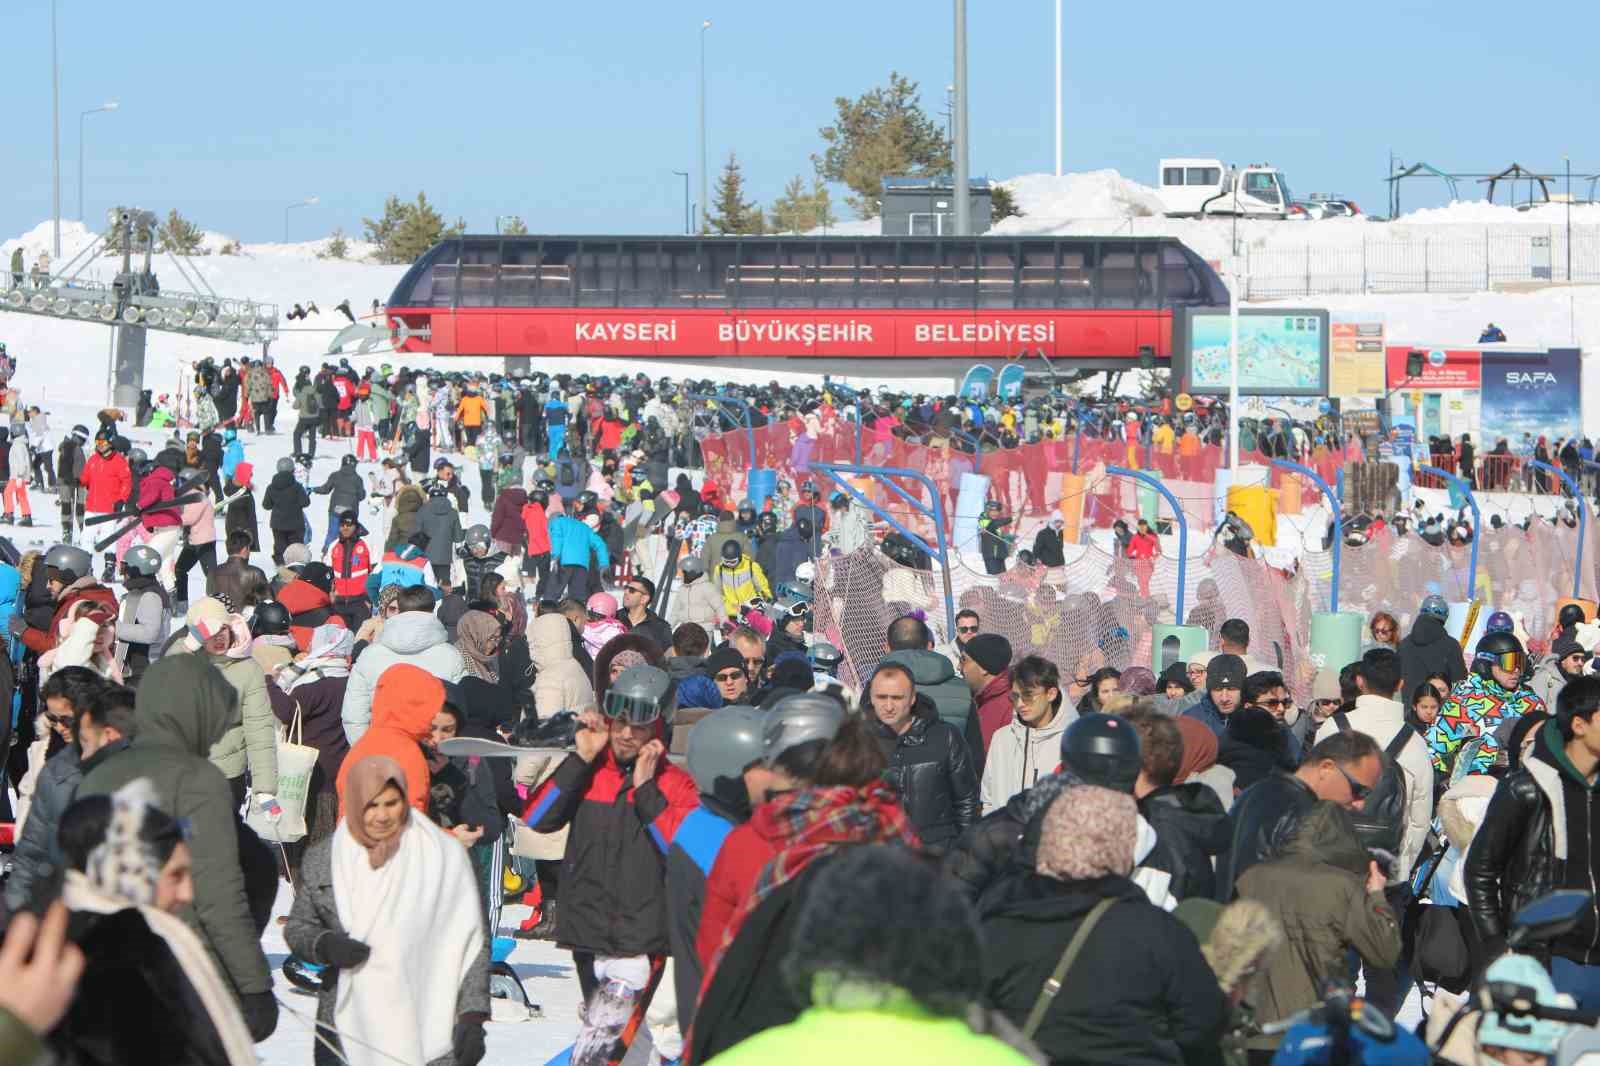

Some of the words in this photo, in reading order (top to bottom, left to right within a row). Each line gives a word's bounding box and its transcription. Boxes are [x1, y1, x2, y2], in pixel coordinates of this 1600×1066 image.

[575, 320, 677, 342] KAYSERİ
[718, 320, 873, 345] BÜYÜKŞEHİR
[914, 320, 1056, 342] BELEDİYESİ
[1506, 371, 1557, 384] SAFA
